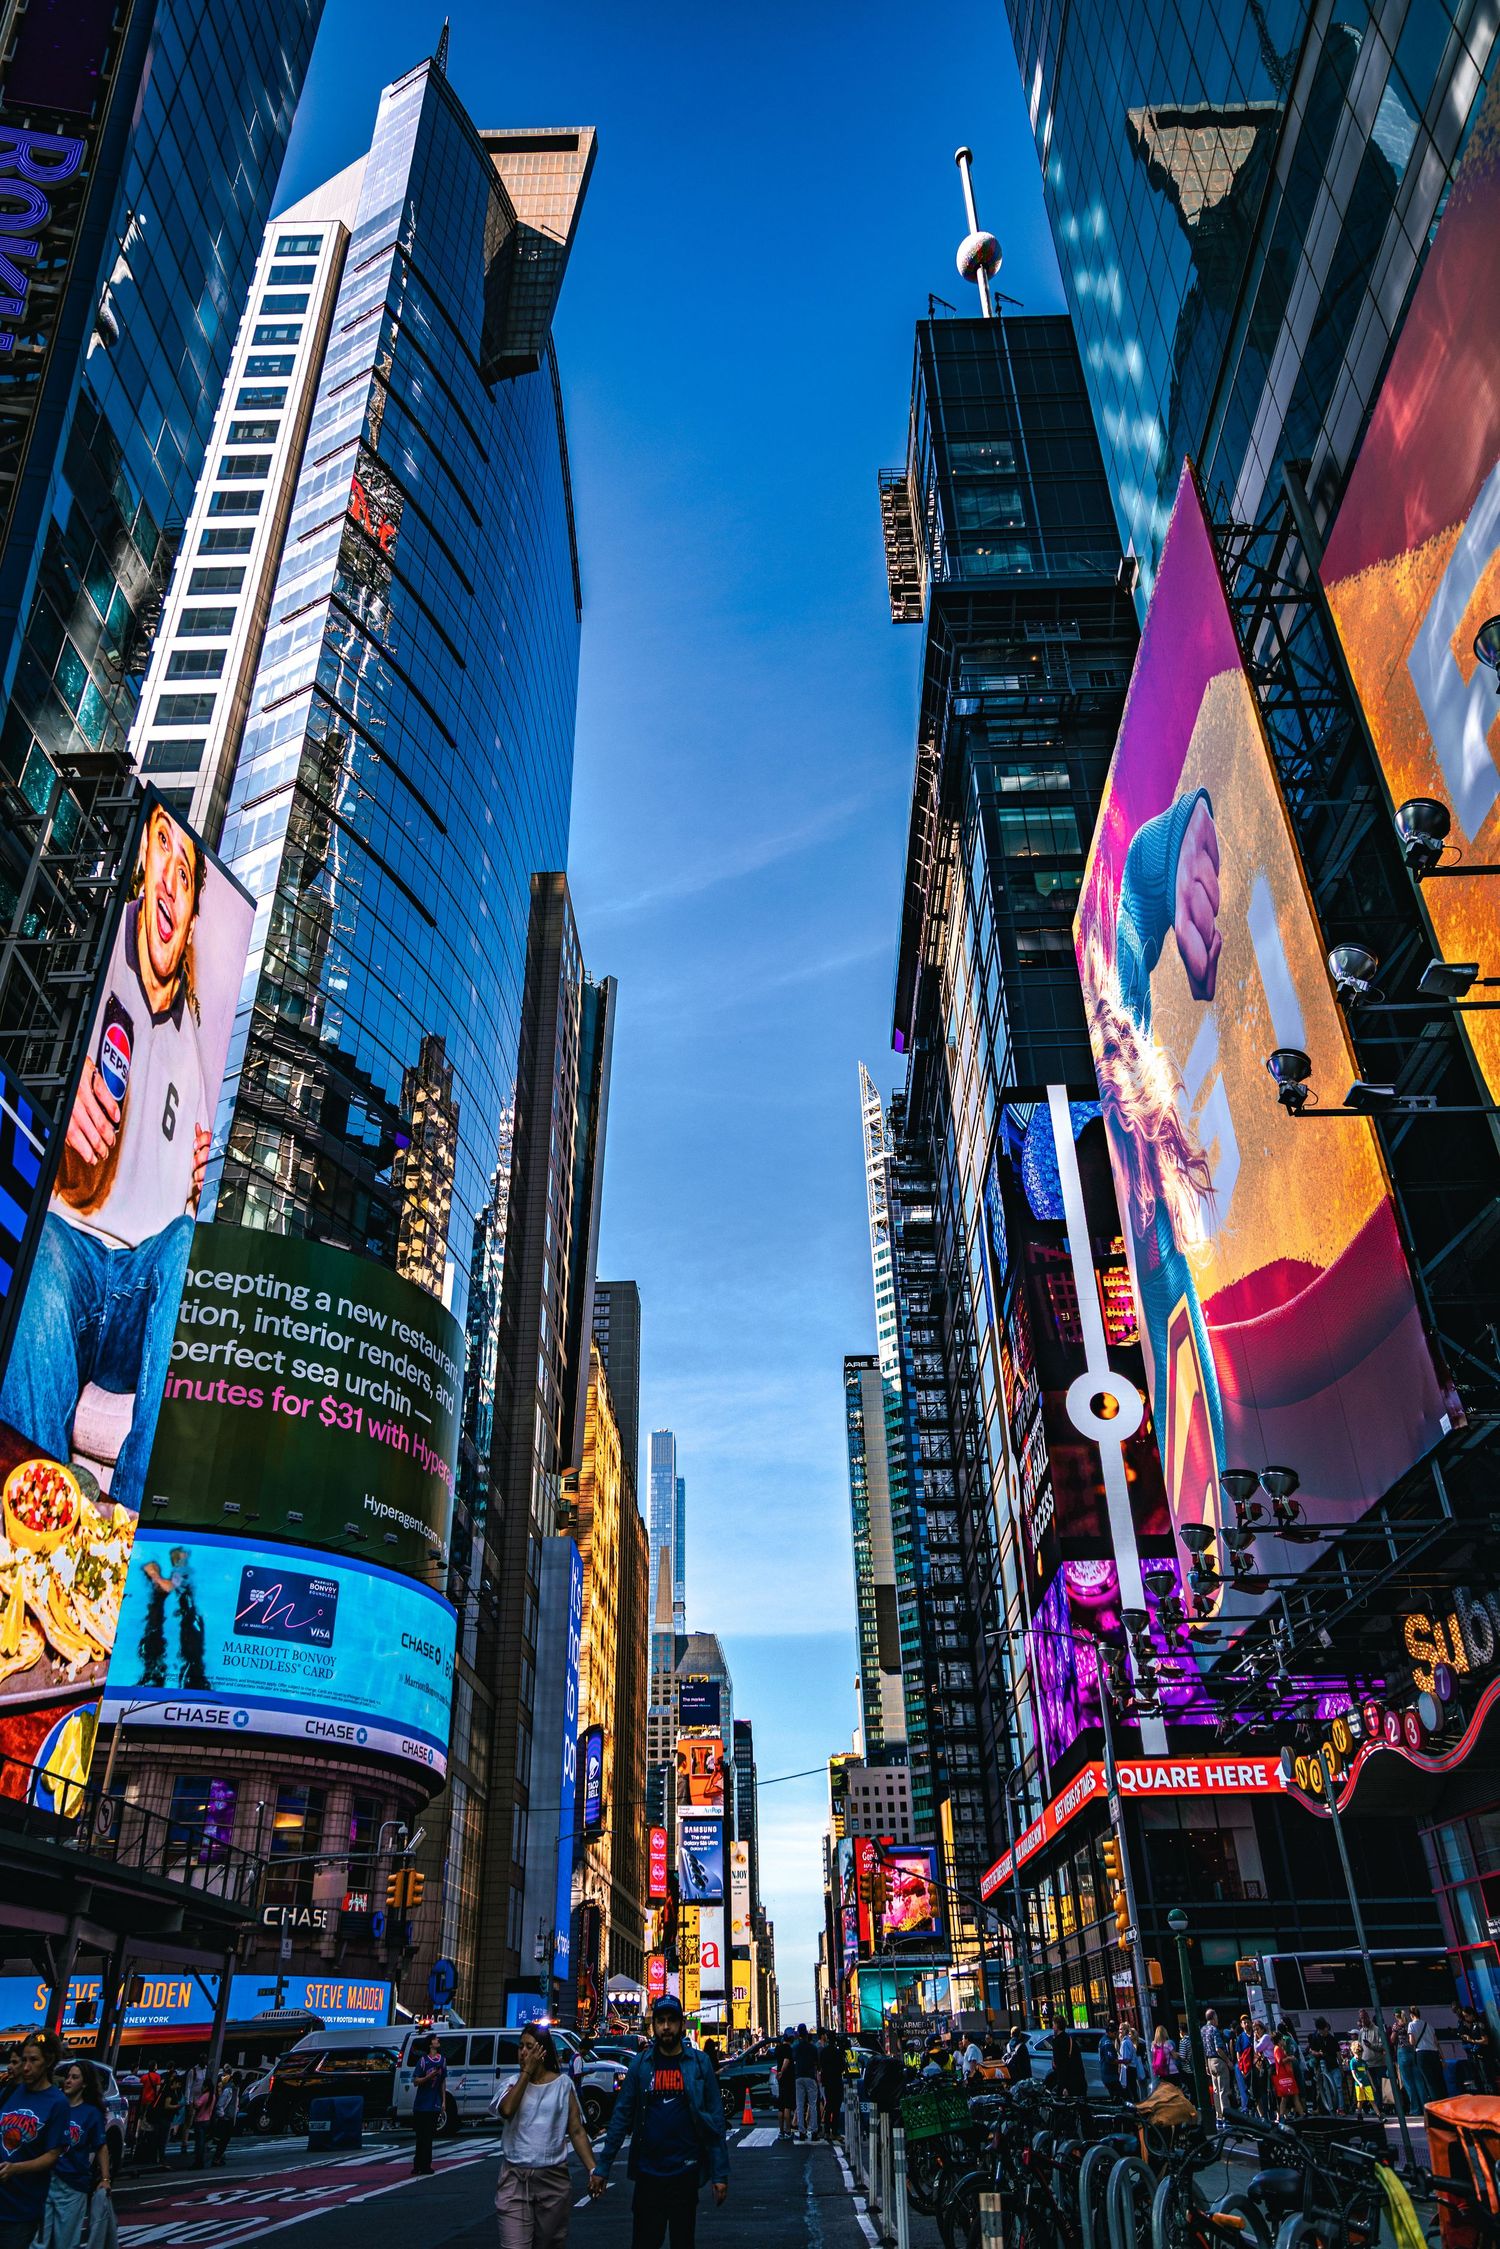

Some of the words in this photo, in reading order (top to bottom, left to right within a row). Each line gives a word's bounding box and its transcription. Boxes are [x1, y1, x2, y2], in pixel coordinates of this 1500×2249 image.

[162, 1082, 179, 1142] 6
[315, 1291, 331, 1312] a
[337, 1297, 388, 1331] new
[179, 1300, 246, 1334] tion,
[253, 1308, 354, 1354] interior
[358, 1340, 433, 1399] renders,
[436, 1384, 454, 1416] and
[168, 1339, 285, 1375] perfect
[291, 1358, 339, 1388] sea
[345, 1376, 411, 1417] urchin
[165, 1371, 263, 1408] inutes
[272, 1385, 313, 1419] for
[319, 1394, 363, 1434] $31
[368, 1418, 409, 1453] with
[1033, 1443, 1049, 1488] BALL
[364, 1493, 438, 1545] Hyperagent.com
[1031, 1483, 1055, 1554] ACCESS
[309, 1583, 337, 1594] BONVOY
[310, 1627, 331, 1639] VISA
[401, 1632, 434, 1660] CHASE
[222, 1641, 290, 1659] MARRIOTT
[292, 1647, 337, 1667] BONVOY
[303, 1665, 333, 1680] CARD
[567, 1668, 575, 1721] to
[164, 1706, 230, 1724] CHASE
[305, 1720, 354, 1740] CHASE
[402, 1740, 428, 1761] CHASE
[588, 1780, 598, 1790] TACO
[588, 1789, 598, 1799] BELL
[1080, 1770, 1096, 1799] TIMES
[1205, 1765, 1268, 1787] HERE
[263, 1907, 328, 1929] CHASE
[701, 1942, 721, 1968] a
[305, 1983, 344, 2009] STEVE
[347, 1986, 385, 2011] MADDEN
[130, 2016, 147, 2024] NEW
[149, 2015, 169, 2023] YORK
[171, 2183, 359, 2207] BUS
